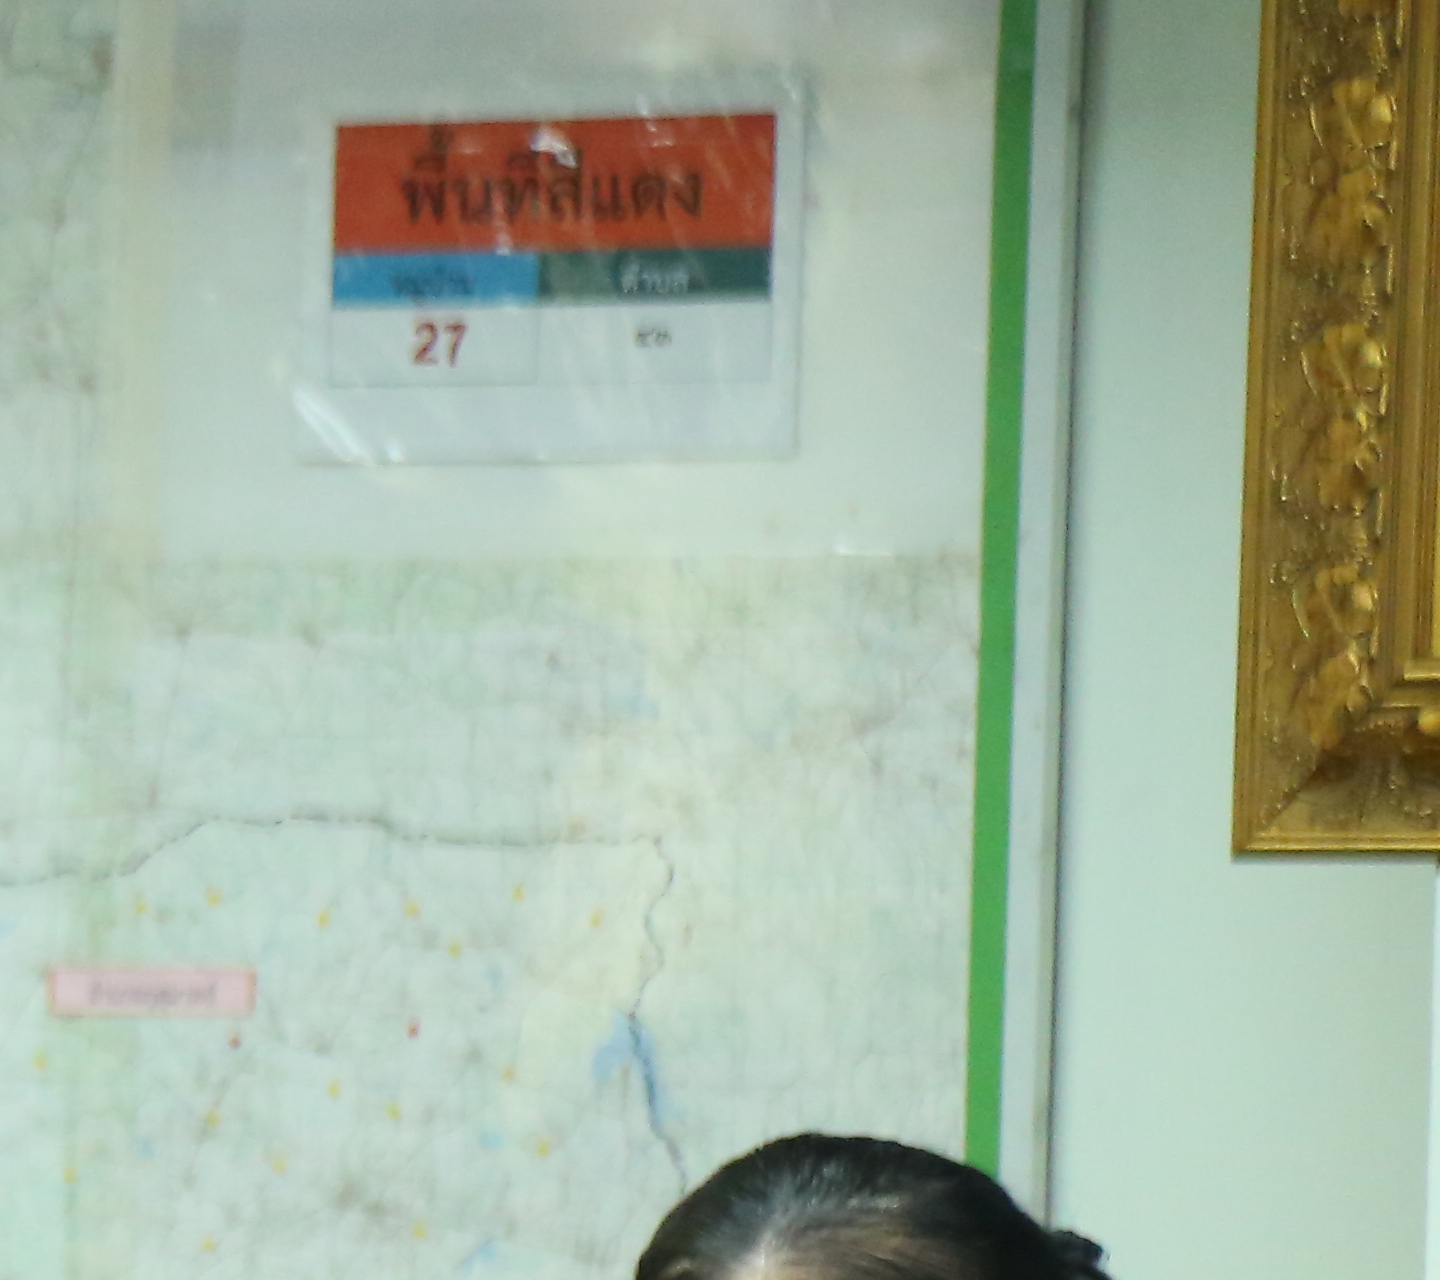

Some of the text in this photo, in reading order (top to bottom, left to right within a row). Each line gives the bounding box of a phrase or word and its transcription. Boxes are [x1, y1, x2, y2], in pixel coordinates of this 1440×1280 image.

[399, 126, 703, 225] พื้นทีสีแดง
[412, 321, 468, 368] 27
